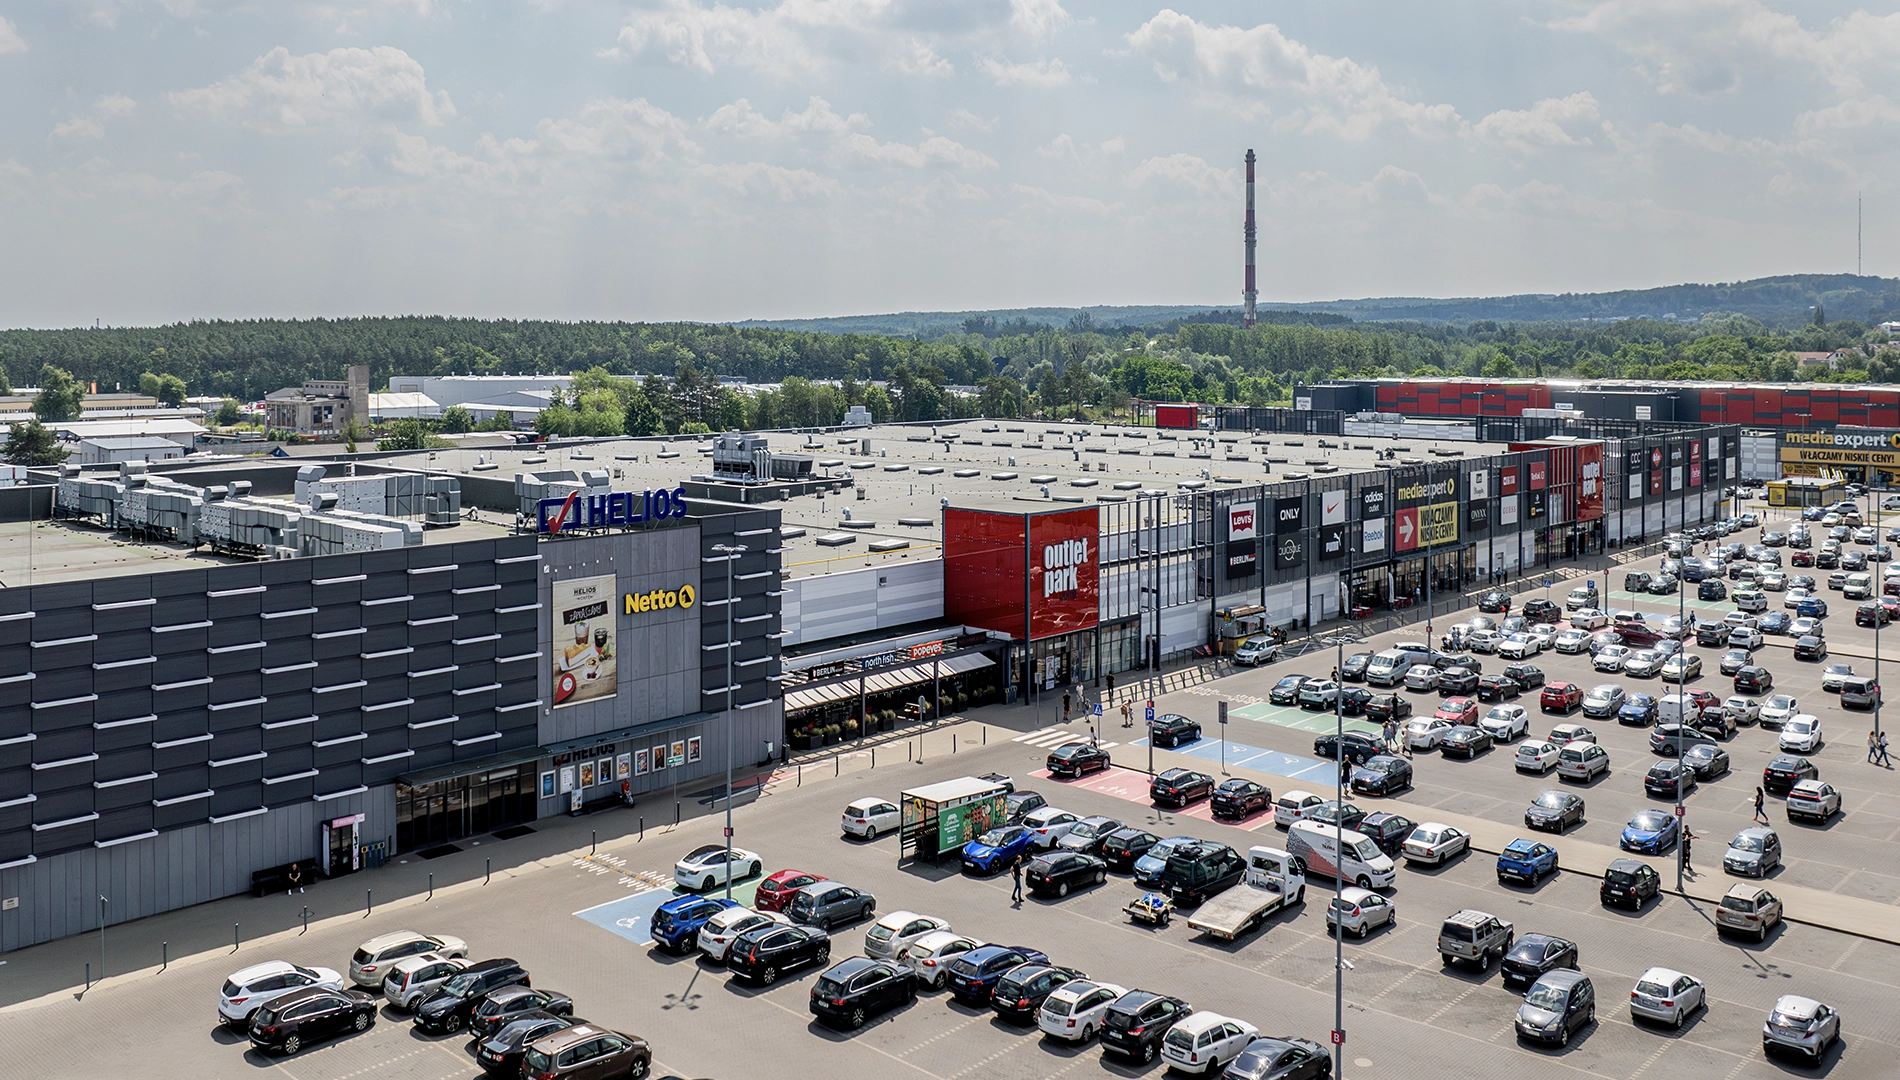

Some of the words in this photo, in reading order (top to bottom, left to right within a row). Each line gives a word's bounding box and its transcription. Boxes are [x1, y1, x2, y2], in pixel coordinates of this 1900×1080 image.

[1786, 430, 1887, 448] mediaexpert
[1631, 452, 1641, 464] CCC
[1844, 452, 1870, 462] NISKIE
[1871, 453, 1895, 464] CENY!
[1364, 491, 1383, 503] adidas
[588, 487, 688, 528] HELIOS
[1280, 508, 1300, 521] ONLY
[1364, 530, 1384, 542] Reebok
[1043, 537, 1088, 569] outlet
[1233, 555, 1249, 566] BERLIN
[1043, 564, 1078, 598] park
[573, 587, 597, 596] HELIOS
[625, 589, 677, 615] Netto
[864, 655, 882, 668] north
[882, 653, 895, 665] fish
[817, 666, 836, 676] BERLIN
[1148, 710, 1152, 718] P
[1334, 1033, 1340, 1042] B
